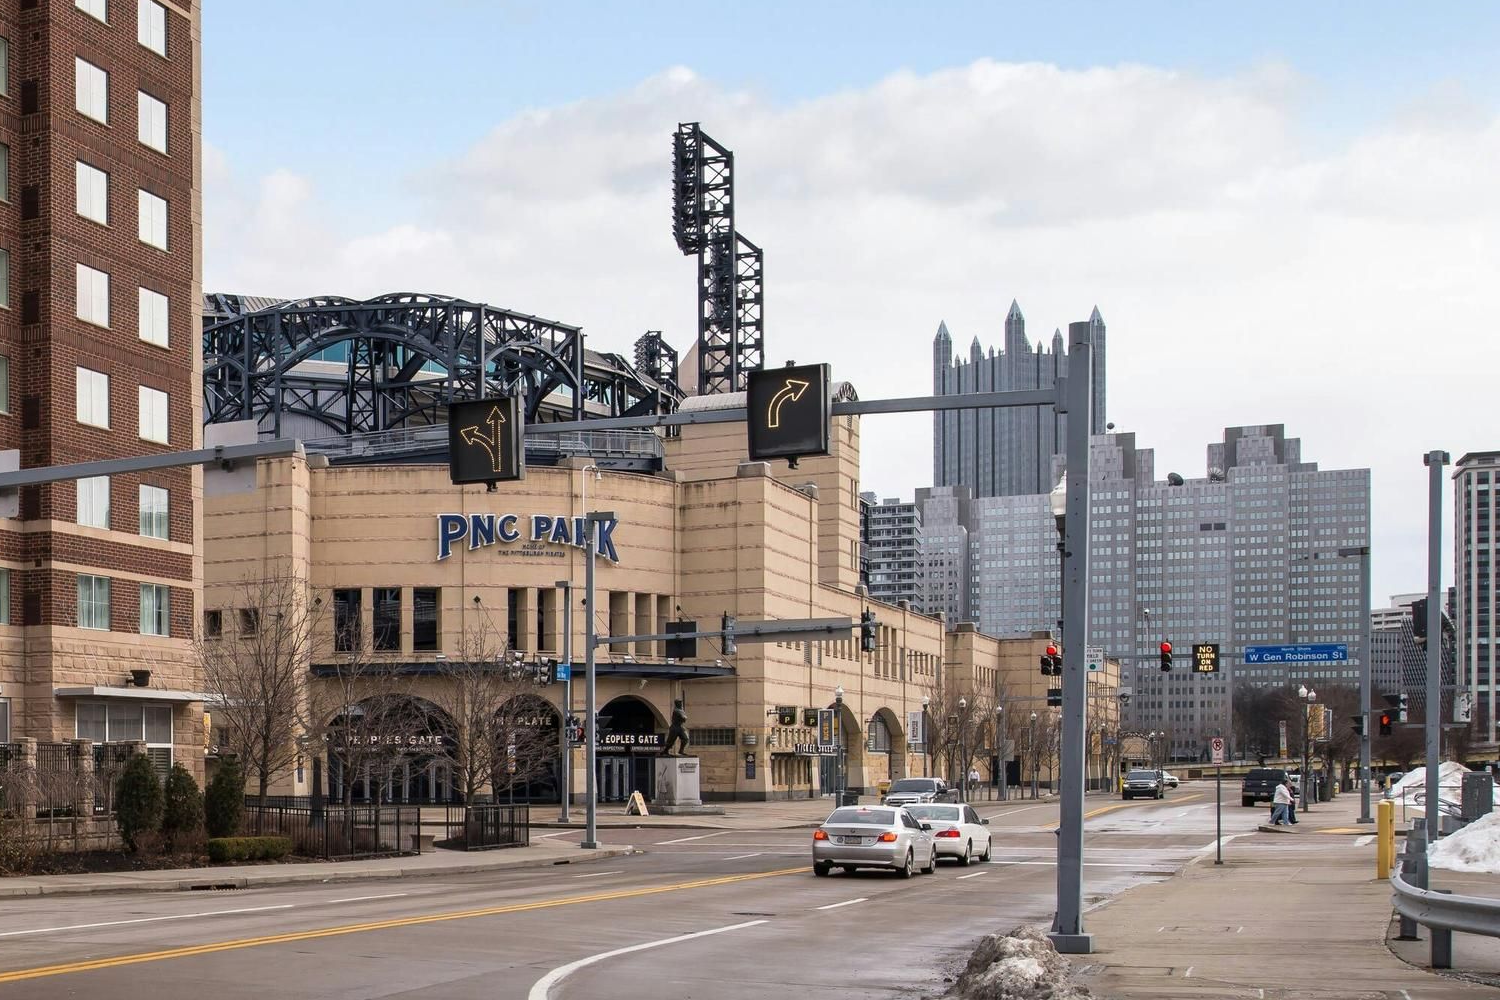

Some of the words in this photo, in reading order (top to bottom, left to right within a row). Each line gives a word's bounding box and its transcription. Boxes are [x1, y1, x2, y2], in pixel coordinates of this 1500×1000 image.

[437, 514, 521, 561] PNC
[1263, 653, 1282, 661] Gen
[1285, 652, 1328, 660] Robinson
[1332, 651, 1343, 659] St
[517, 717, 552, 726] PLATE
[408, 735, 443, 745] GATE
[600, 734, 635, 744] EOPLES
[638, 735, 659, 744] GATE
